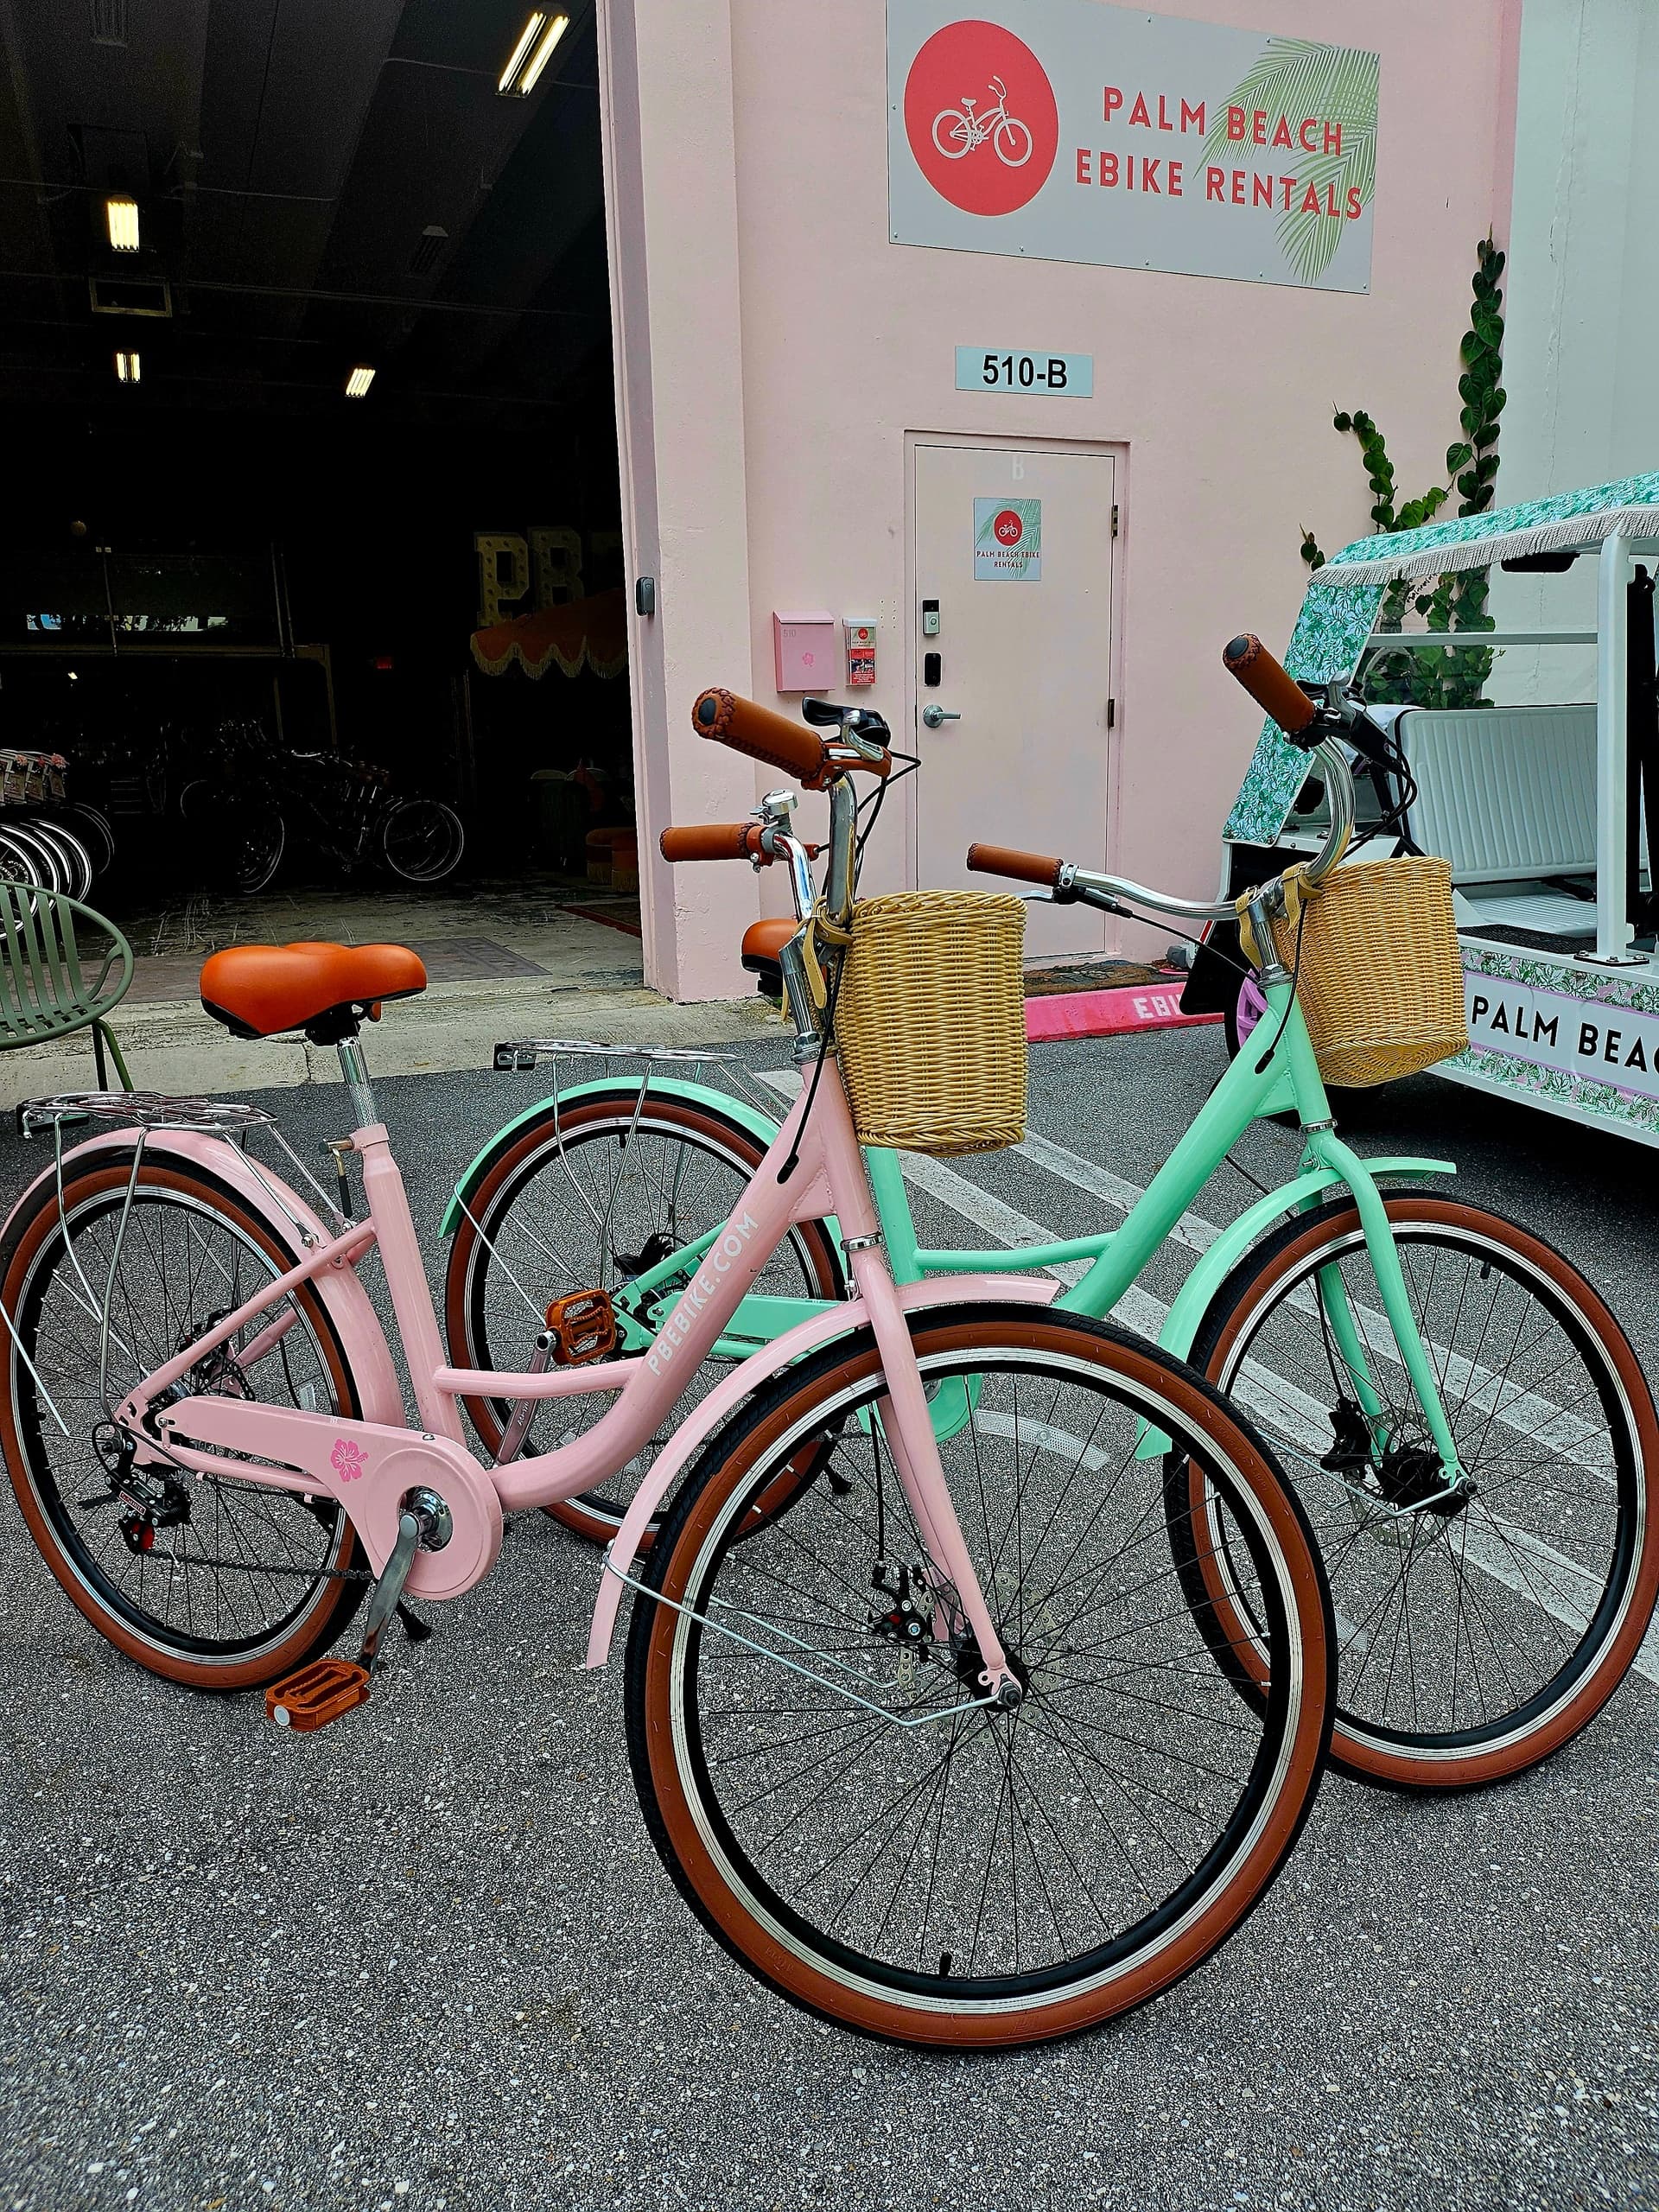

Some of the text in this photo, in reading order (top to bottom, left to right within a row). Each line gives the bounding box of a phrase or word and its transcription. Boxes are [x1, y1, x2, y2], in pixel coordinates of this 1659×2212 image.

[1103, 86, 1342, 156] PALM BEACH
[1077, 149, 1362, 219] EBIKE RENTALS
[982, 354, 1068, 389] 510-B
[1012, 454, 1024, 480] B
[1471, 995, 1659, 1074] PALM BEA
[648, 1211, 759, 1376] PBEBIKE.COM
